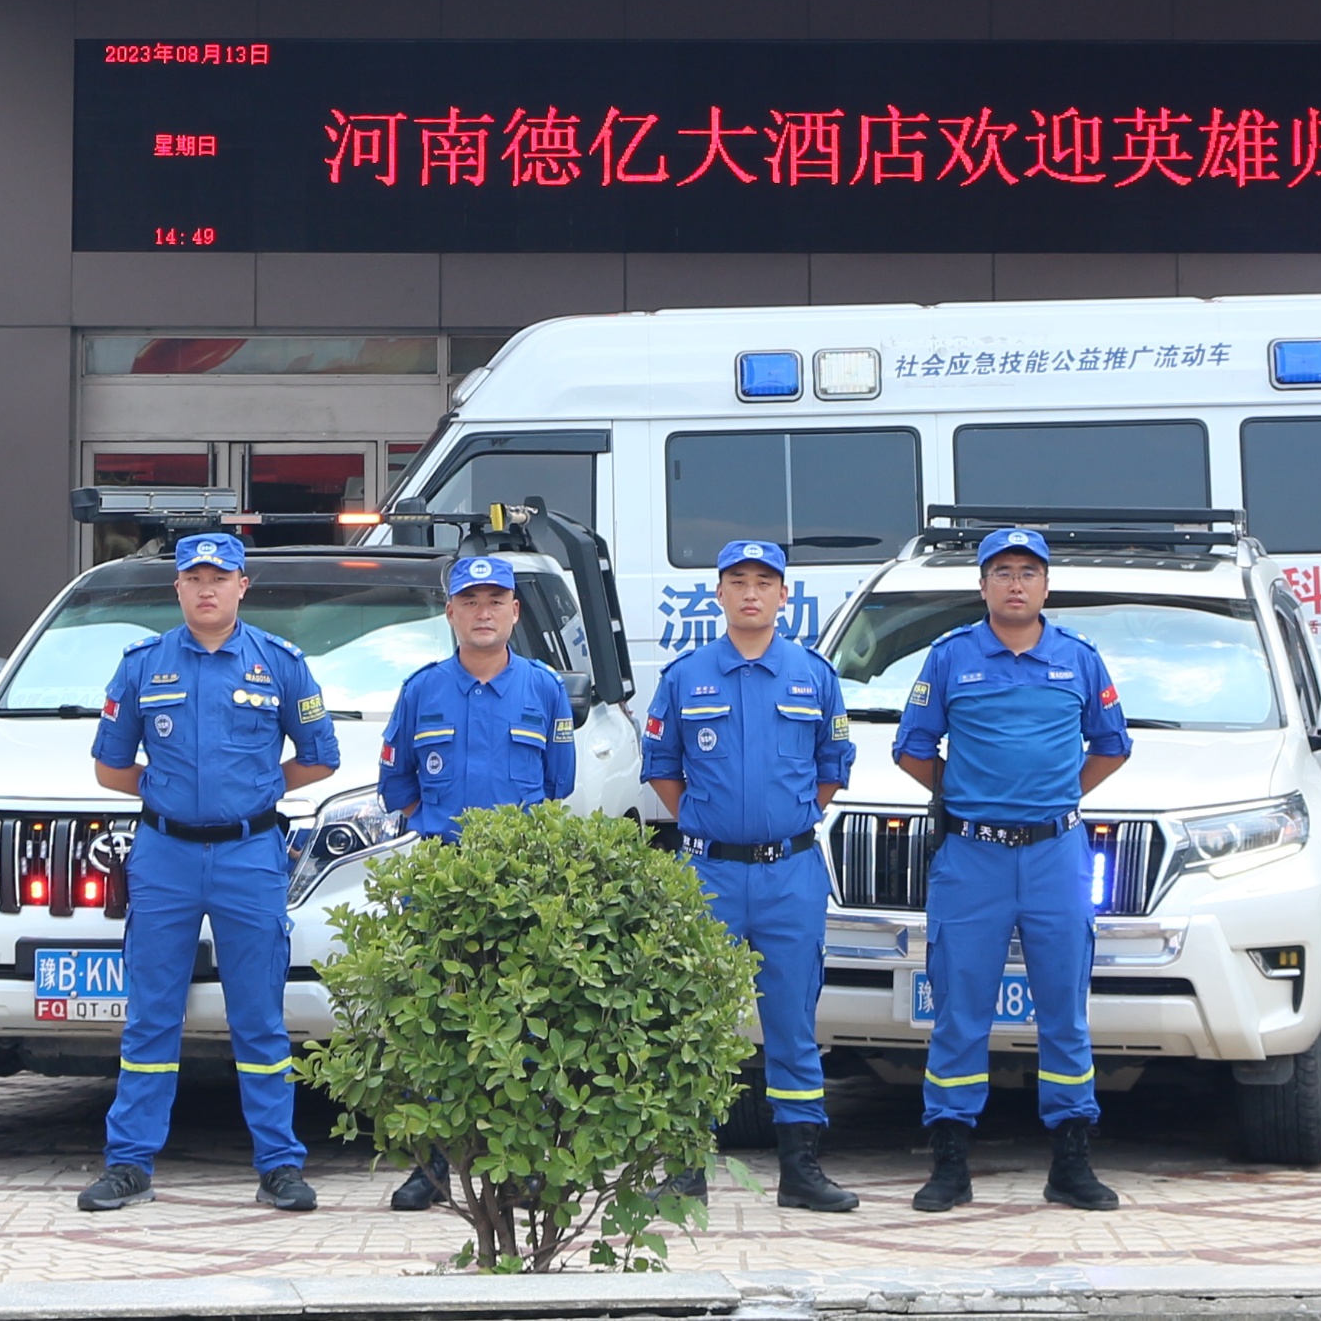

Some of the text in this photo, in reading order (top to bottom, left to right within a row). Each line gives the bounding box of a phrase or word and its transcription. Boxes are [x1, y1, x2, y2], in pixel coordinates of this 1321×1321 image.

[104, 43, 270, 66] 2023年08月13日
[153, 134, 217, 157] 星期日
[154, 227, 216, 246] 14:49
[894, 342, 1232, 379] 社会应急技能公益推广流动车
[658, 581, 864, 652] 流动
[39, 957, 124, 991] 豫B·KN
